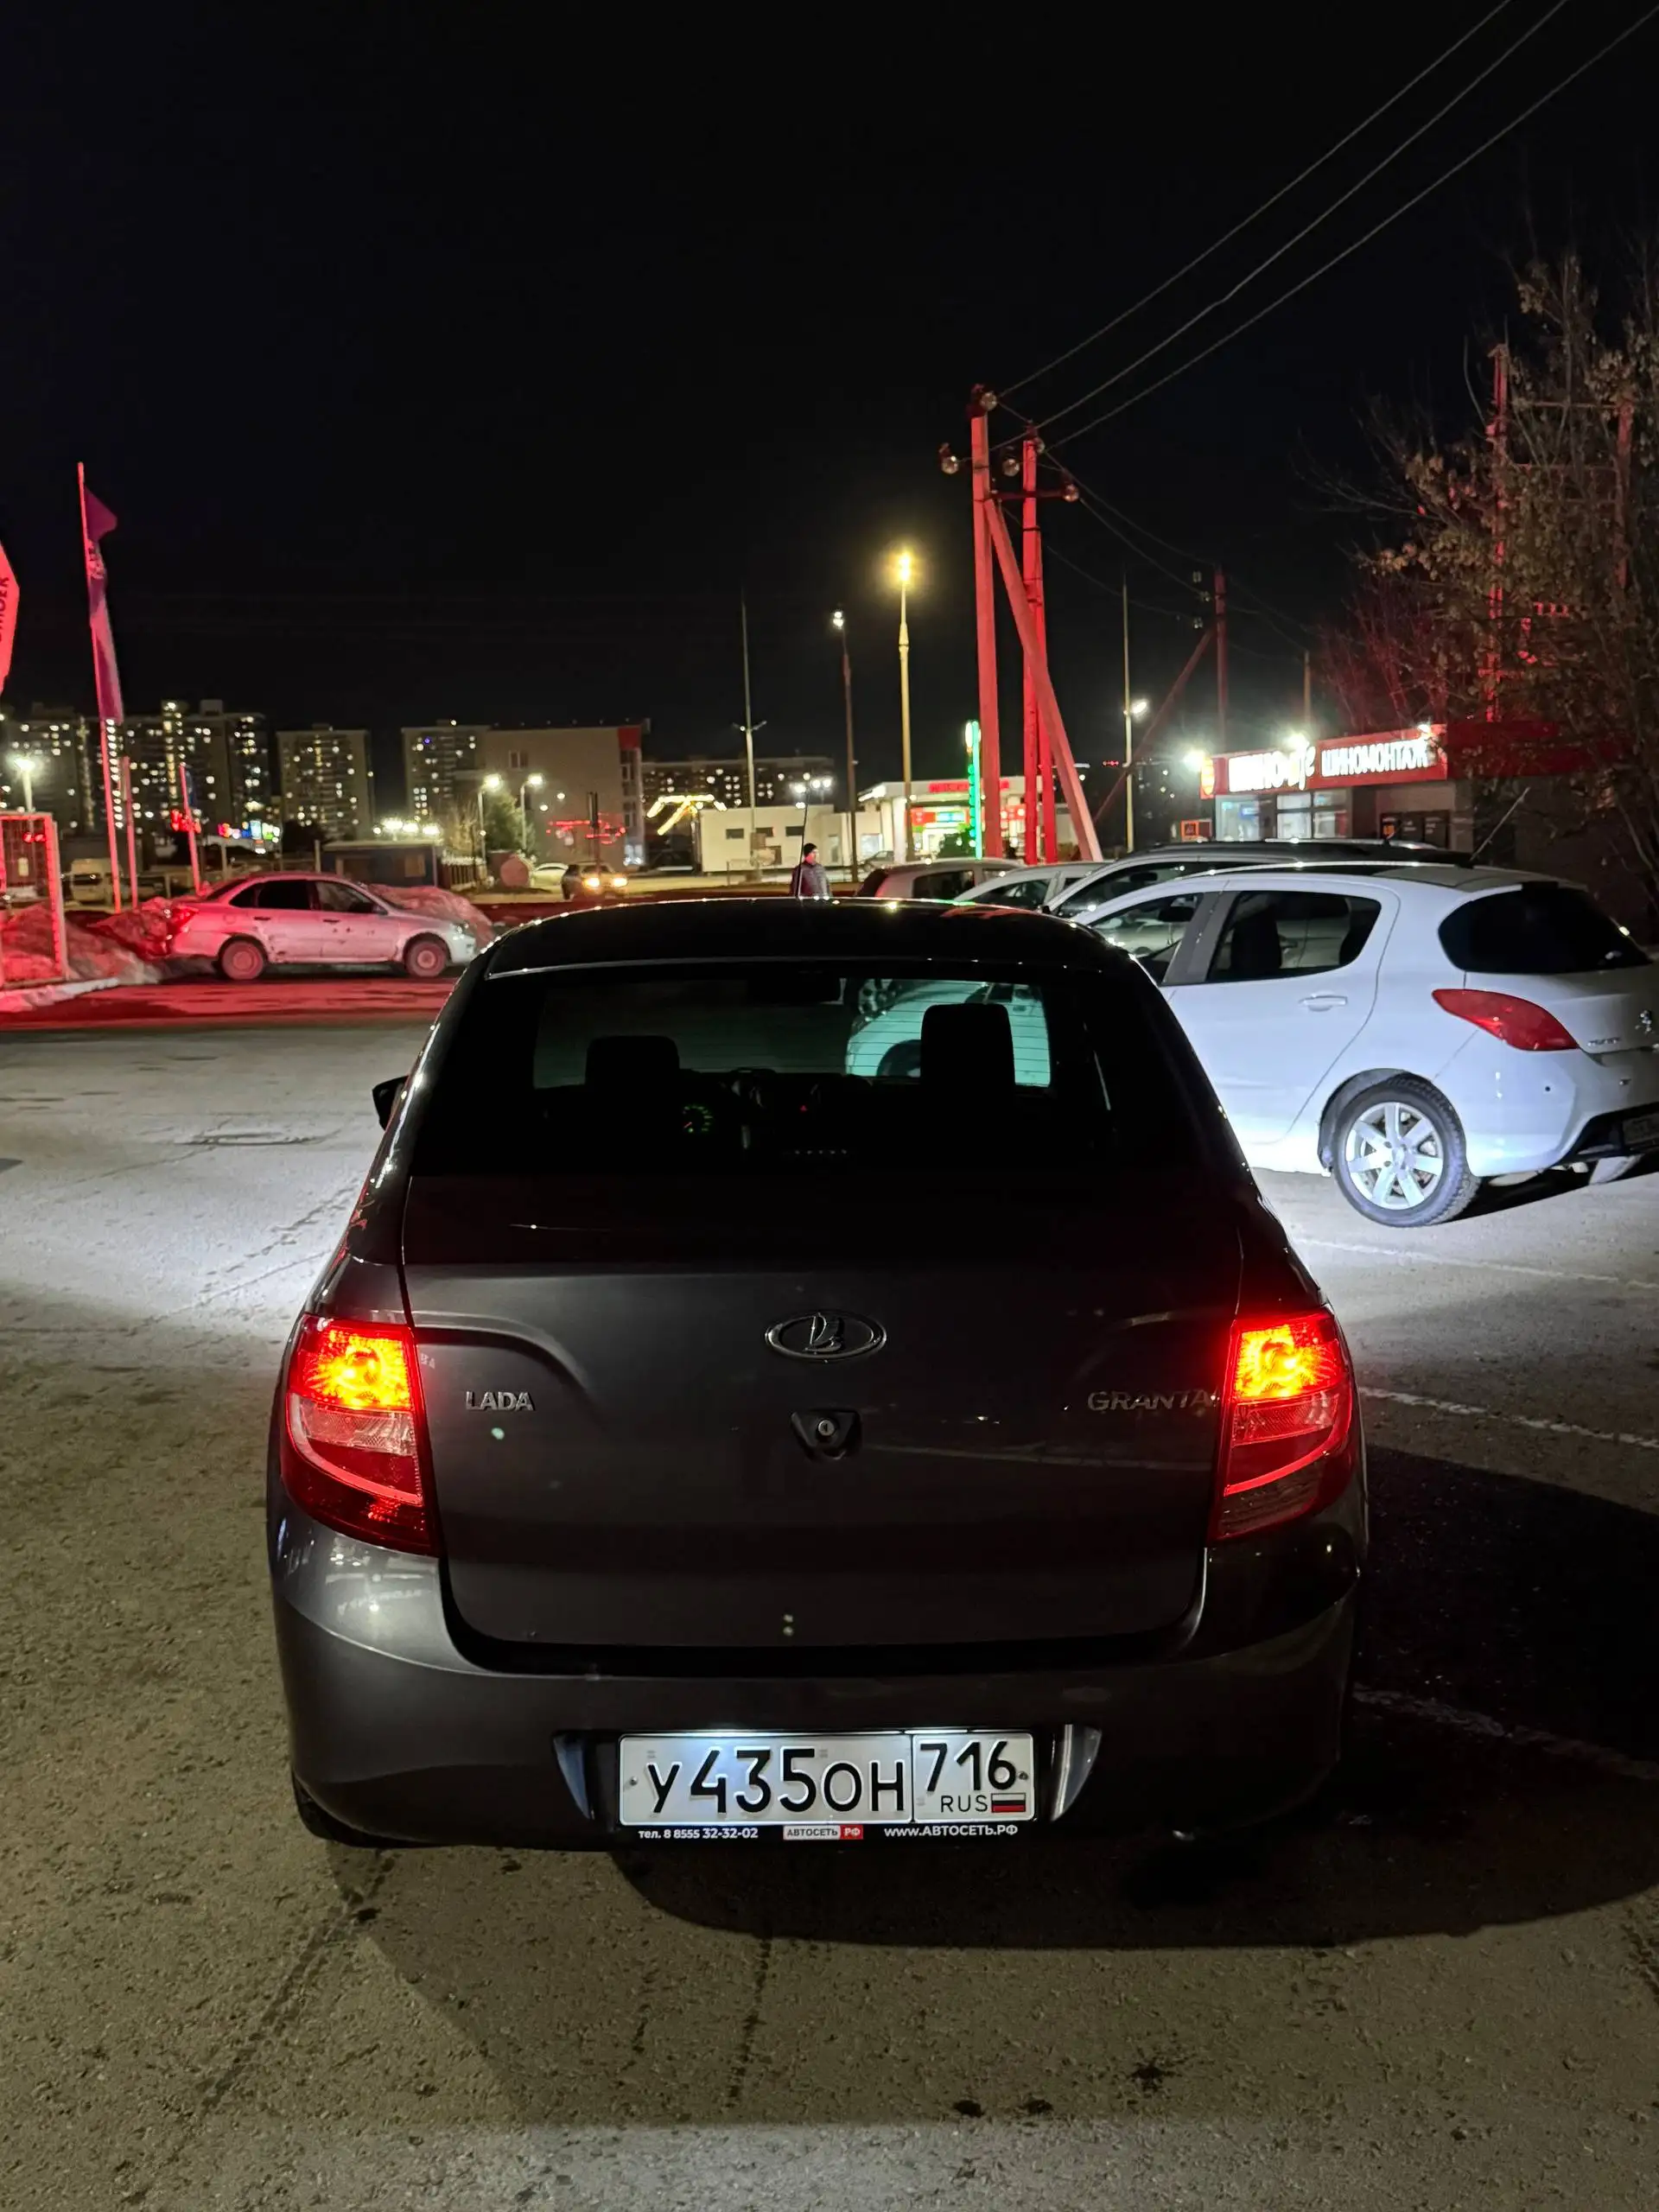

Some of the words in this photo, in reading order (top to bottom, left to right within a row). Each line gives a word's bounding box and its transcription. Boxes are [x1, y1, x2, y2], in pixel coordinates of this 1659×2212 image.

[466, 1391, 535, 1411] LADA
[1087, 1389, 1213, 1411] GRANTA
[920, 1741, 1016, 1791] 716
[940, 1795, 988, 1813] RUS
[638, 1830, 662, 1840] тел.
[663, 1829, 671, 1839] 8
[673, 1828, 700, 1839] 8555
[702, 1827, 758, 1839] 32-32-02
[786, 1827, 838, 1838] АВТОСЕТЬ
[844, 1827, 861, 1837] РФ
[884, 1825, 1018, 1837] www.АВТОСЕТЬ.РФ
